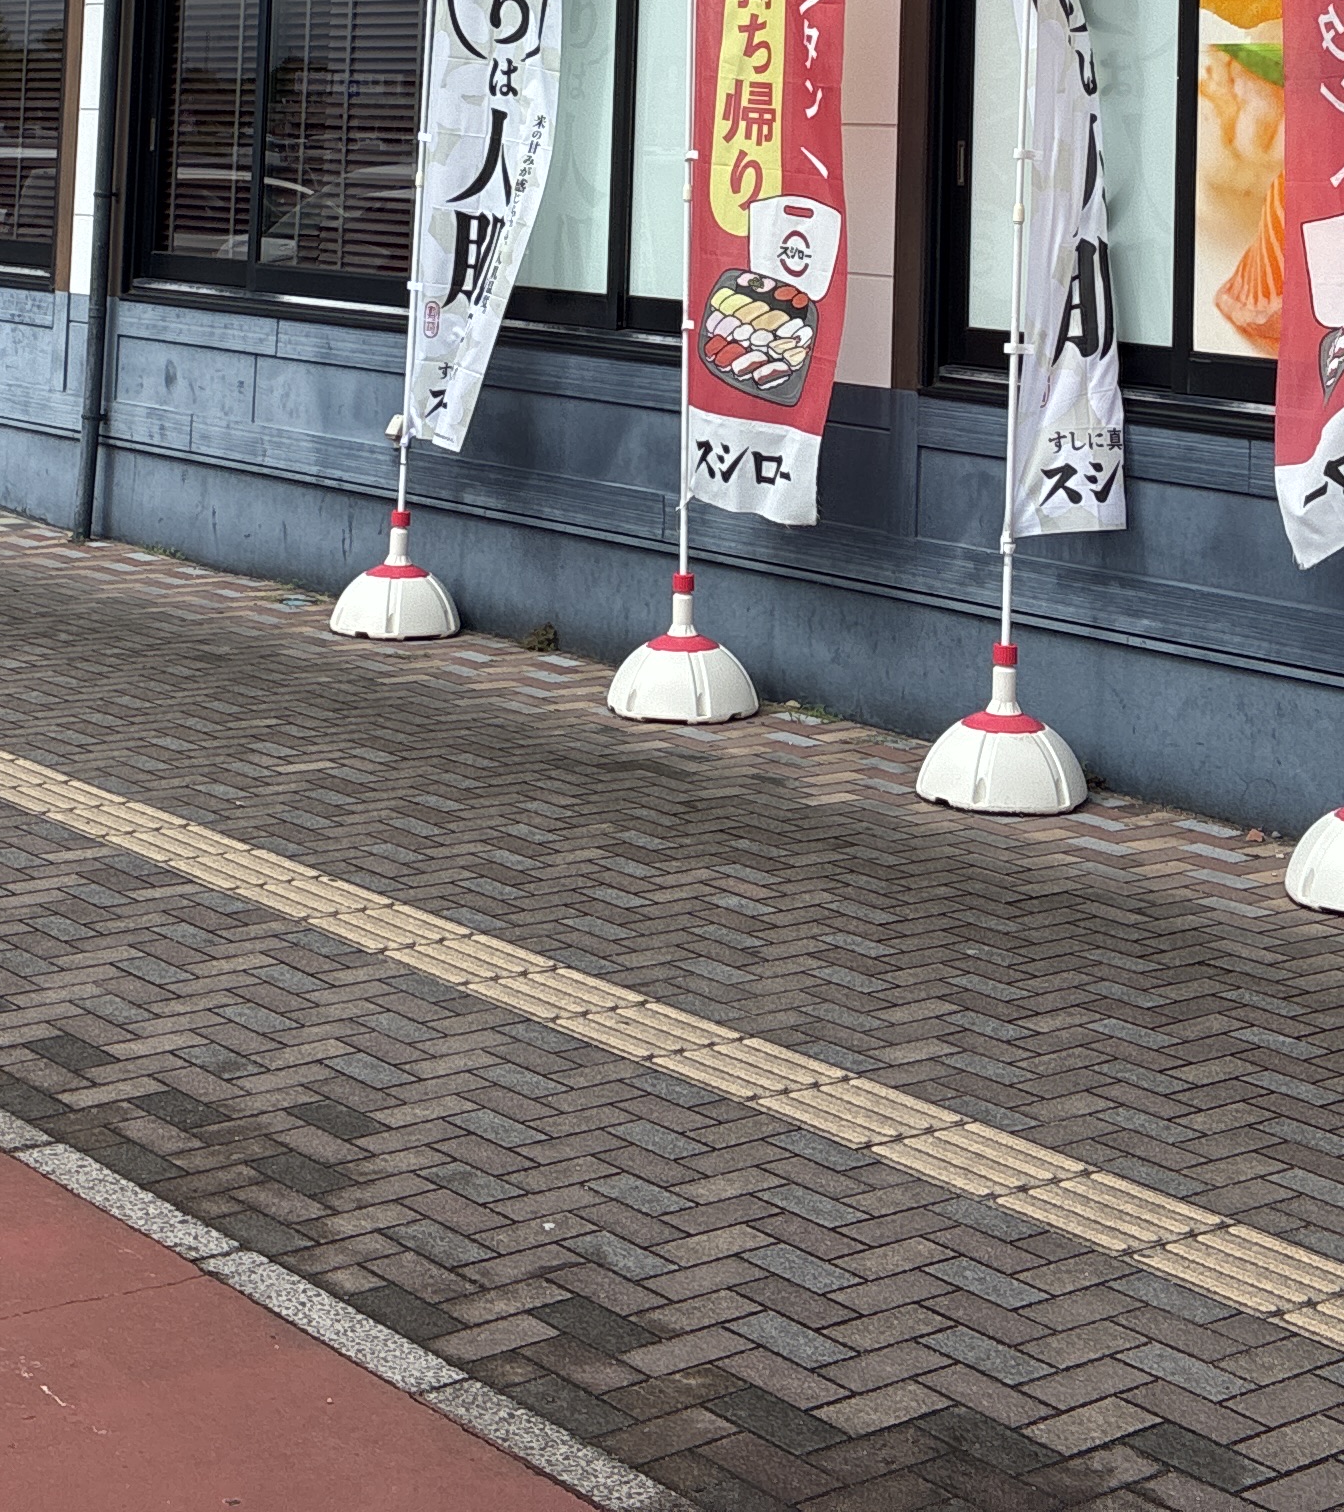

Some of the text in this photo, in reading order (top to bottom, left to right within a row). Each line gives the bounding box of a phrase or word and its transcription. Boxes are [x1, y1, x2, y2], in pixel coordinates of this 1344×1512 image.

[777, 246, 812, 260] スシロー
[1048, 428, 1123, 454] すしに真
[695, 439, 792, 486] スシロー
[1039, 460, 1121, 507] スシ
